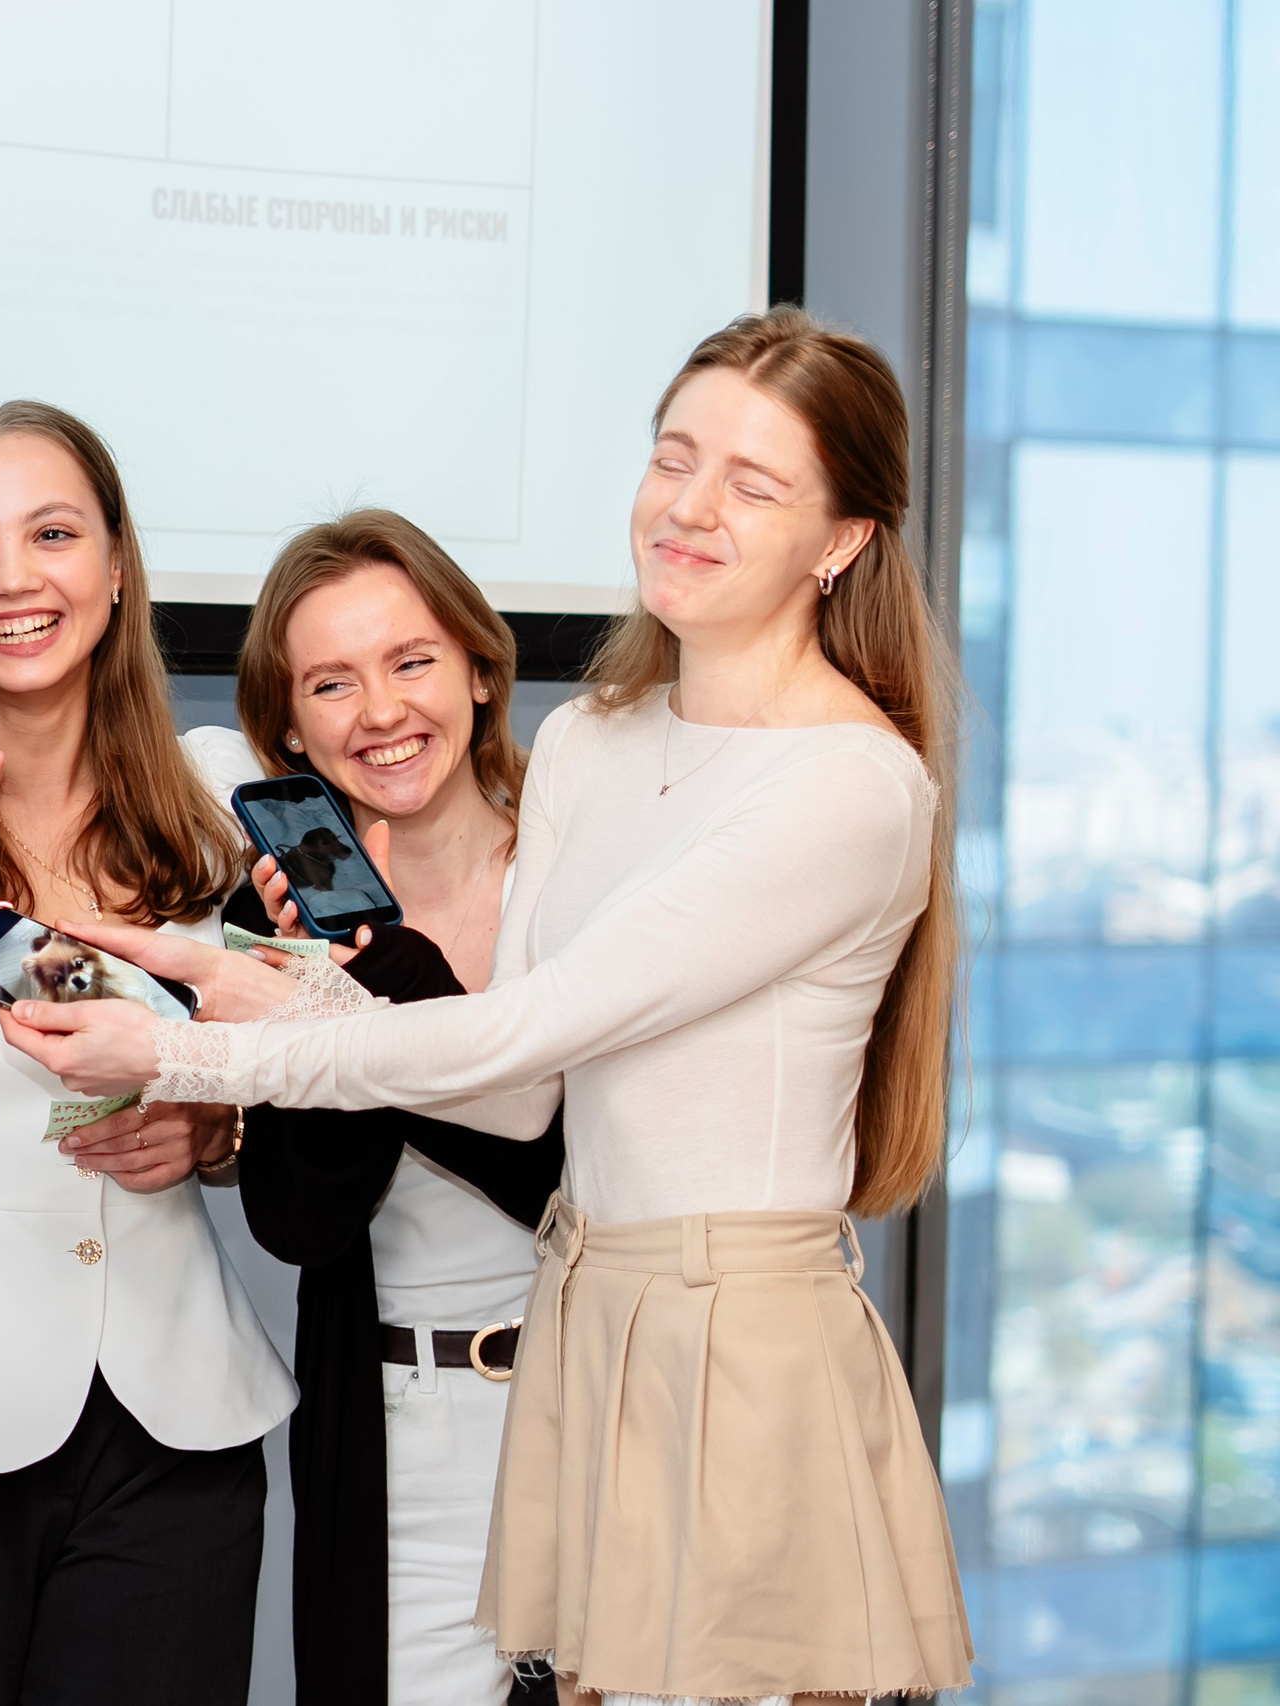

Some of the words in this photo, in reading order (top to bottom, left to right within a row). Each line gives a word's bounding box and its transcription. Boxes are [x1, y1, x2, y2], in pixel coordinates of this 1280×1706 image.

[151, 187, 259, 227] СЛАБЫЕ
[266, 196, 391, 236] СТОРОНЫ
[399, 205, 417, 238] И
[424, 207, 509, 242] РИСКИ
